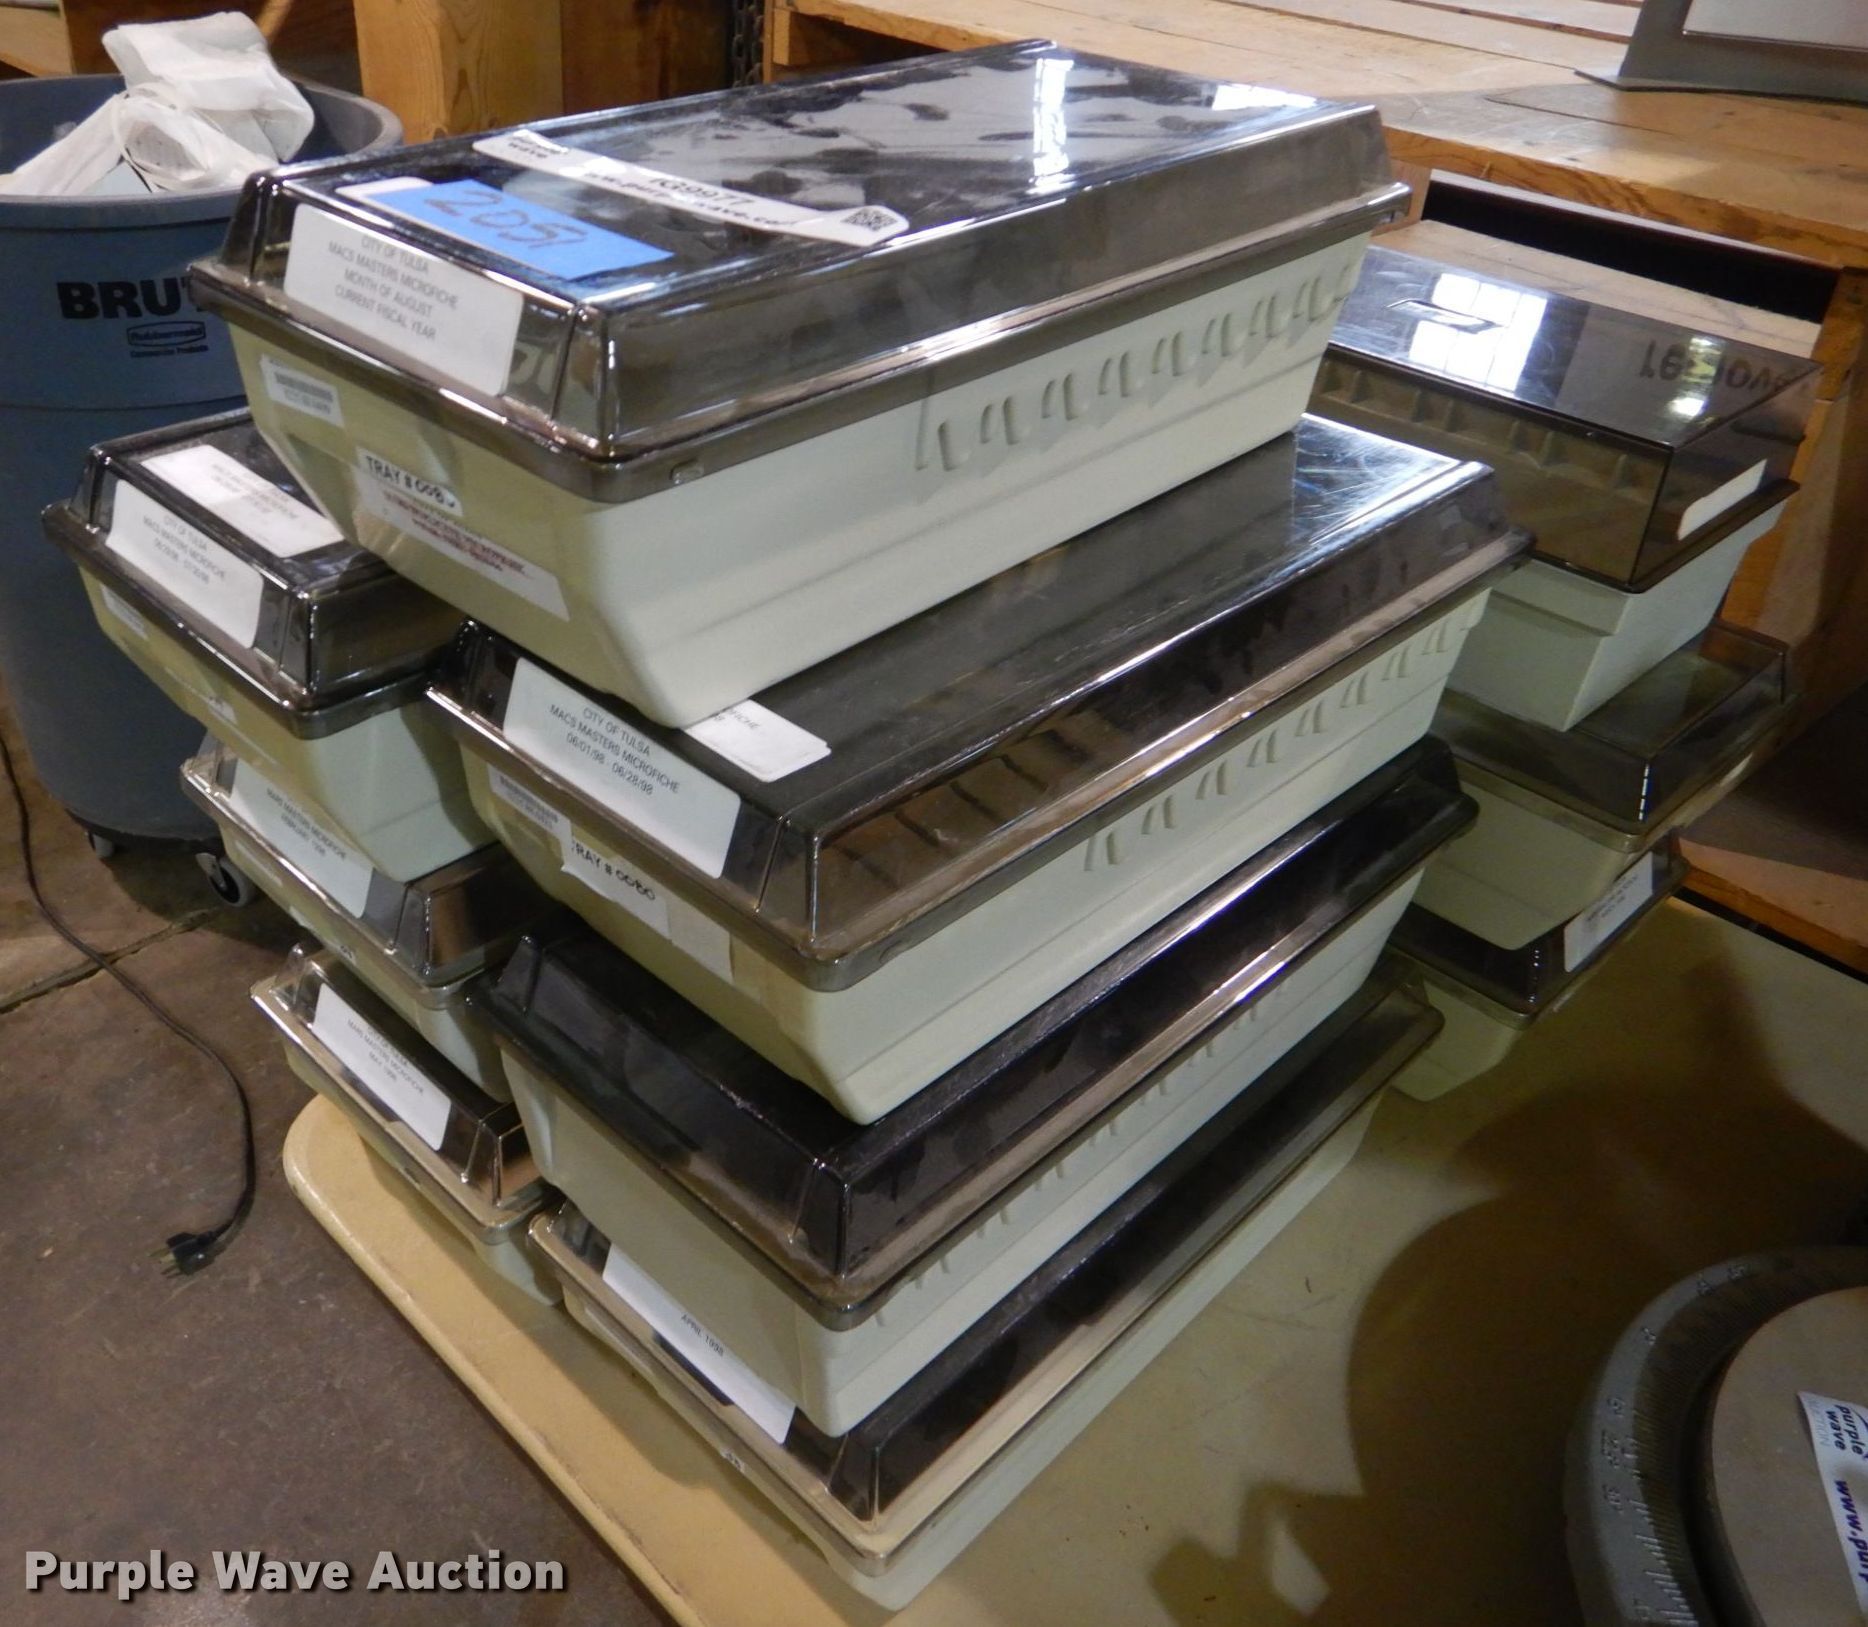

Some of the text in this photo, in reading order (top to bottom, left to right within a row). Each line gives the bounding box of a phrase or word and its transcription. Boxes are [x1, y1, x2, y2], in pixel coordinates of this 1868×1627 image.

[329, 241, 459, 310] MACS MASTERS MICROFICHE
[362, 235, 428, 274] CITY OF TULSA
[335, 284, 437, 340] CURRENT FISCAL YEAR
[344, 268, 433, 316] MONTH OF AUGUST
[365, 455, 400, 484] TRAY
[550, 704, 680, 794] MACS MASTERS MICROFICHE
[583, 707, 651, 757] CITY OF TULSA
[566, 732, 654, 796] 06/01/98 06/28/98
[681, 1314, 724, 1357] APRIL 1998
[1826, 1411, 1846, 1450] wave
[1834, 1404, 1866, 1455] purple
